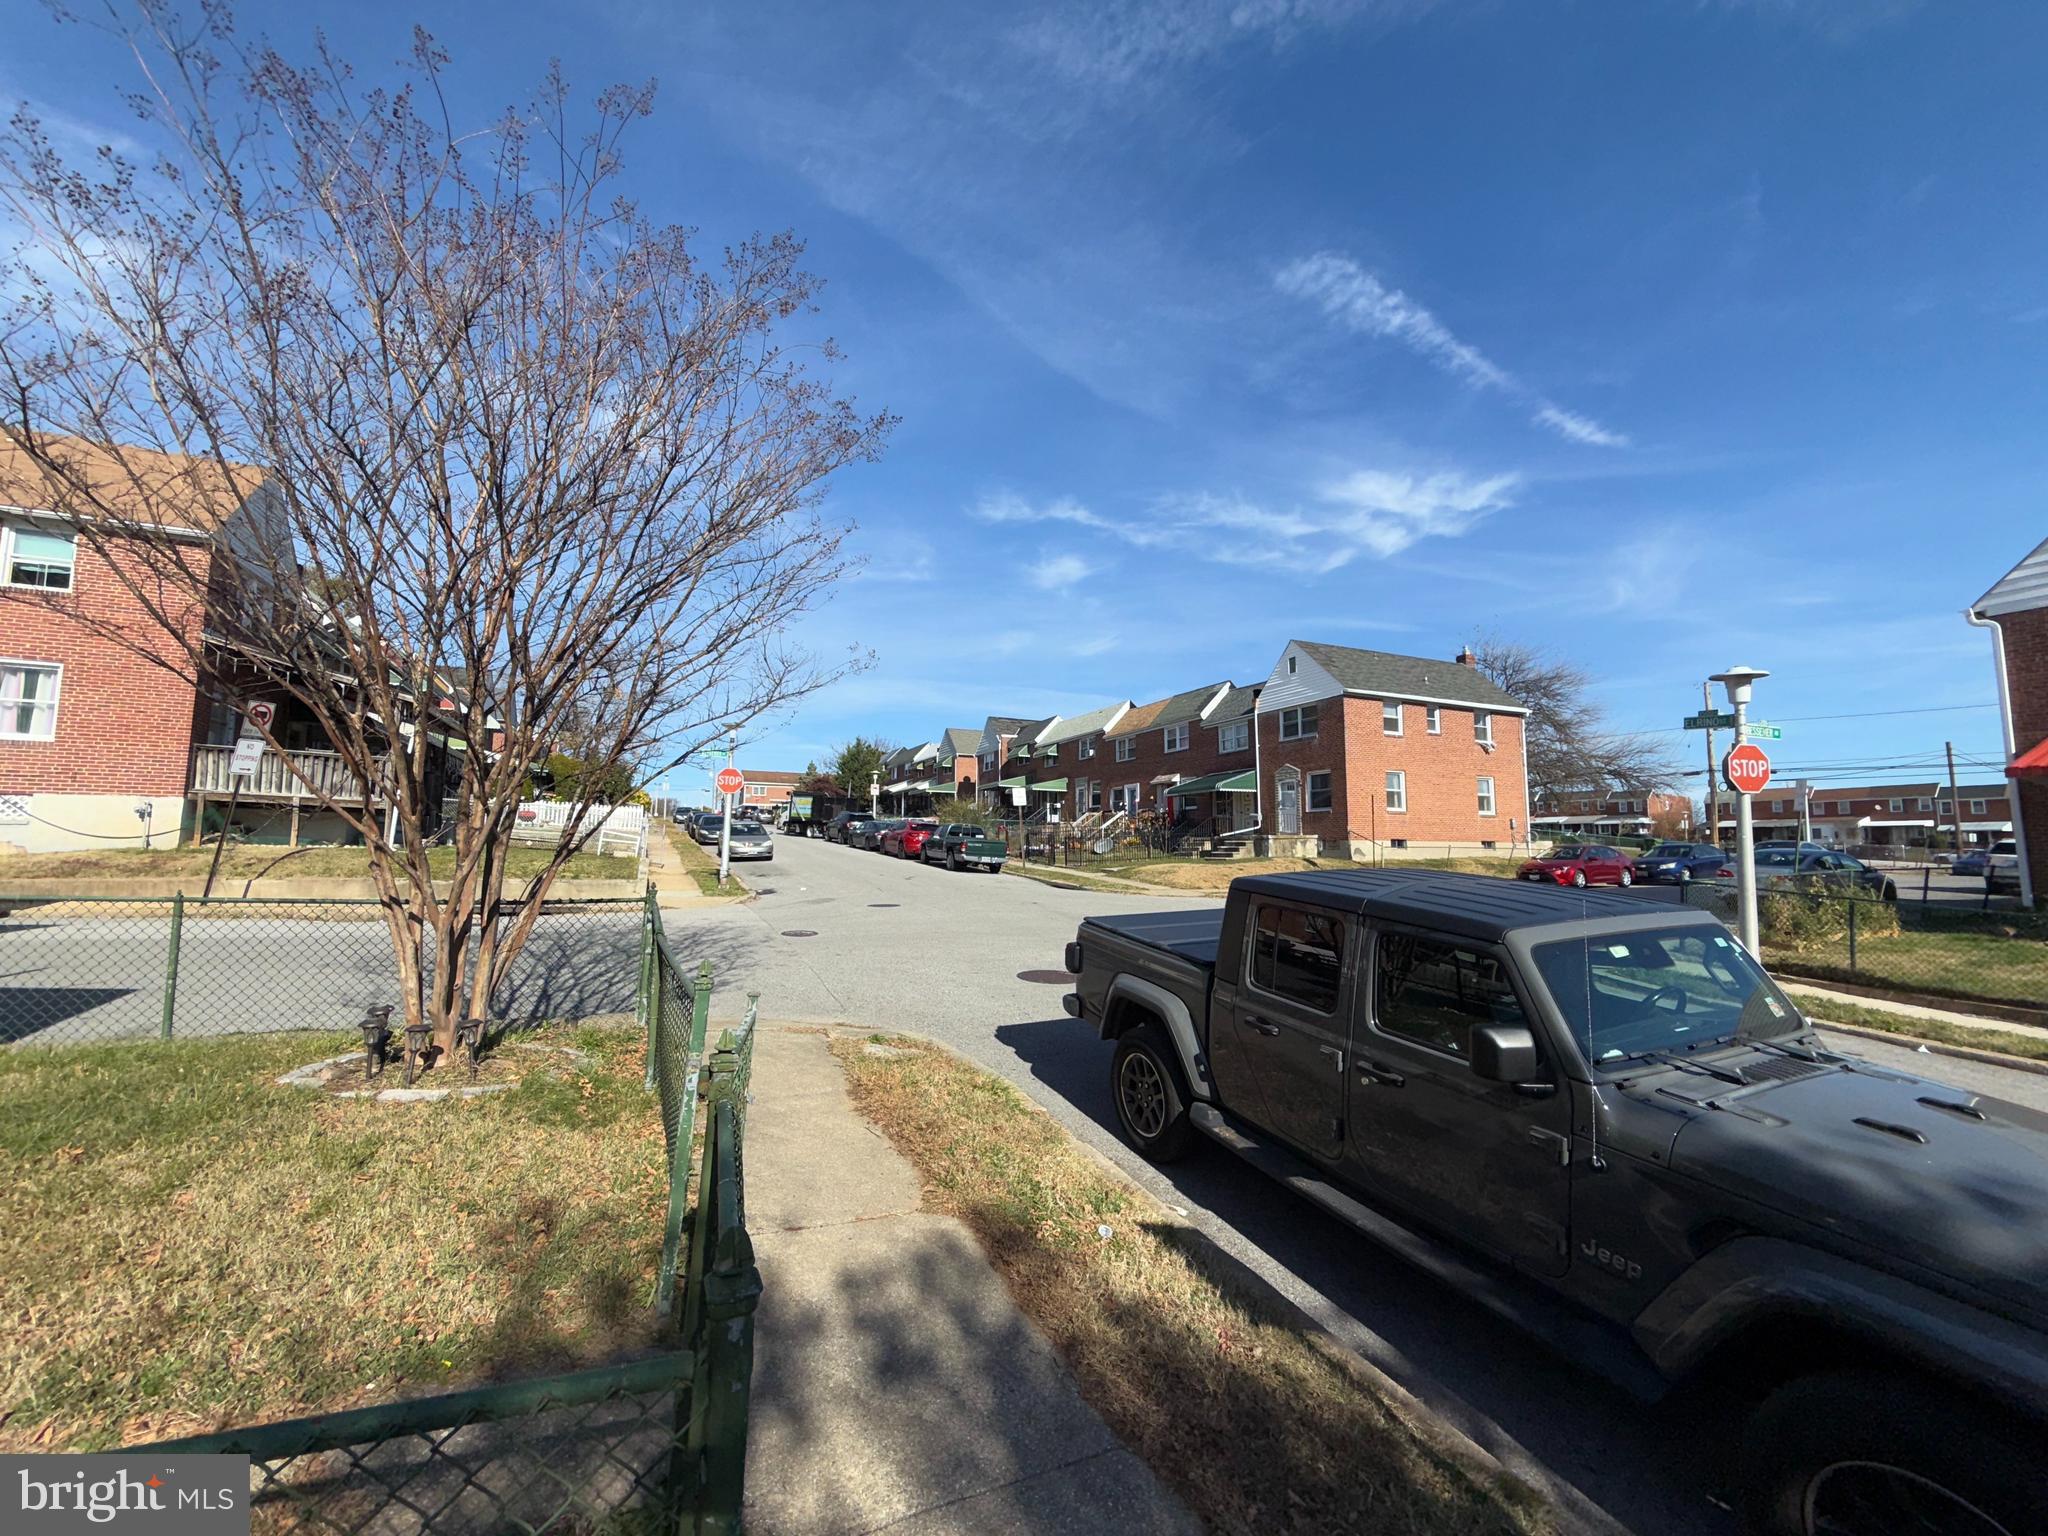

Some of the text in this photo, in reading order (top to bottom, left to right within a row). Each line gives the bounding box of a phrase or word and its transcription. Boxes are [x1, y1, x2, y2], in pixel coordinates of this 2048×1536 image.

[1685, 717, 1719, 728] ELRINO
[1732, 759, 1767, 778] STOP
[718, 775, 742, 786] STOP
[1581, 1239, 1642, 1279] Jeep
